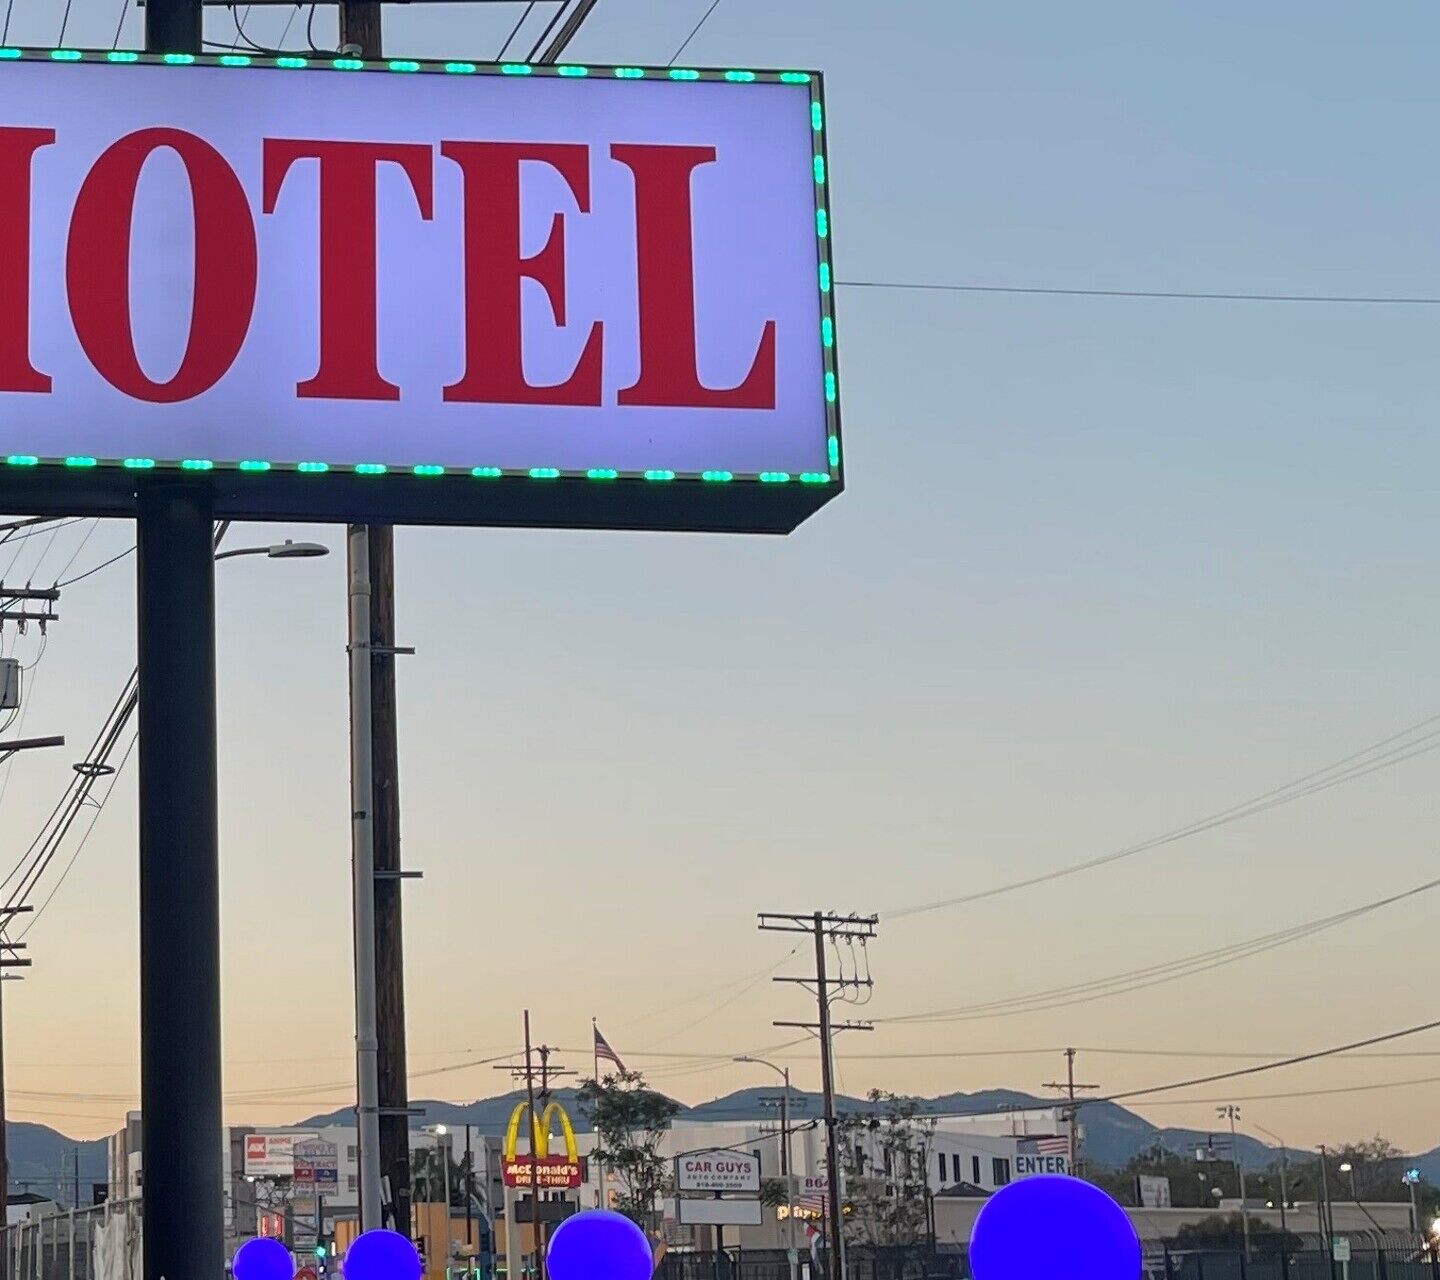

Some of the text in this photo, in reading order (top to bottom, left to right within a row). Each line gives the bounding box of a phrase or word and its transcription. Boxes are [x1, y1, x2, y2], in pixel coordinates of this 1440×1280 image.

[685, 1161, 752, 1174] CAR GUYS
[1015, 1156, 1066, 1174] ENTER
[515, 1175, 570, 1185] DRIE-THRU
